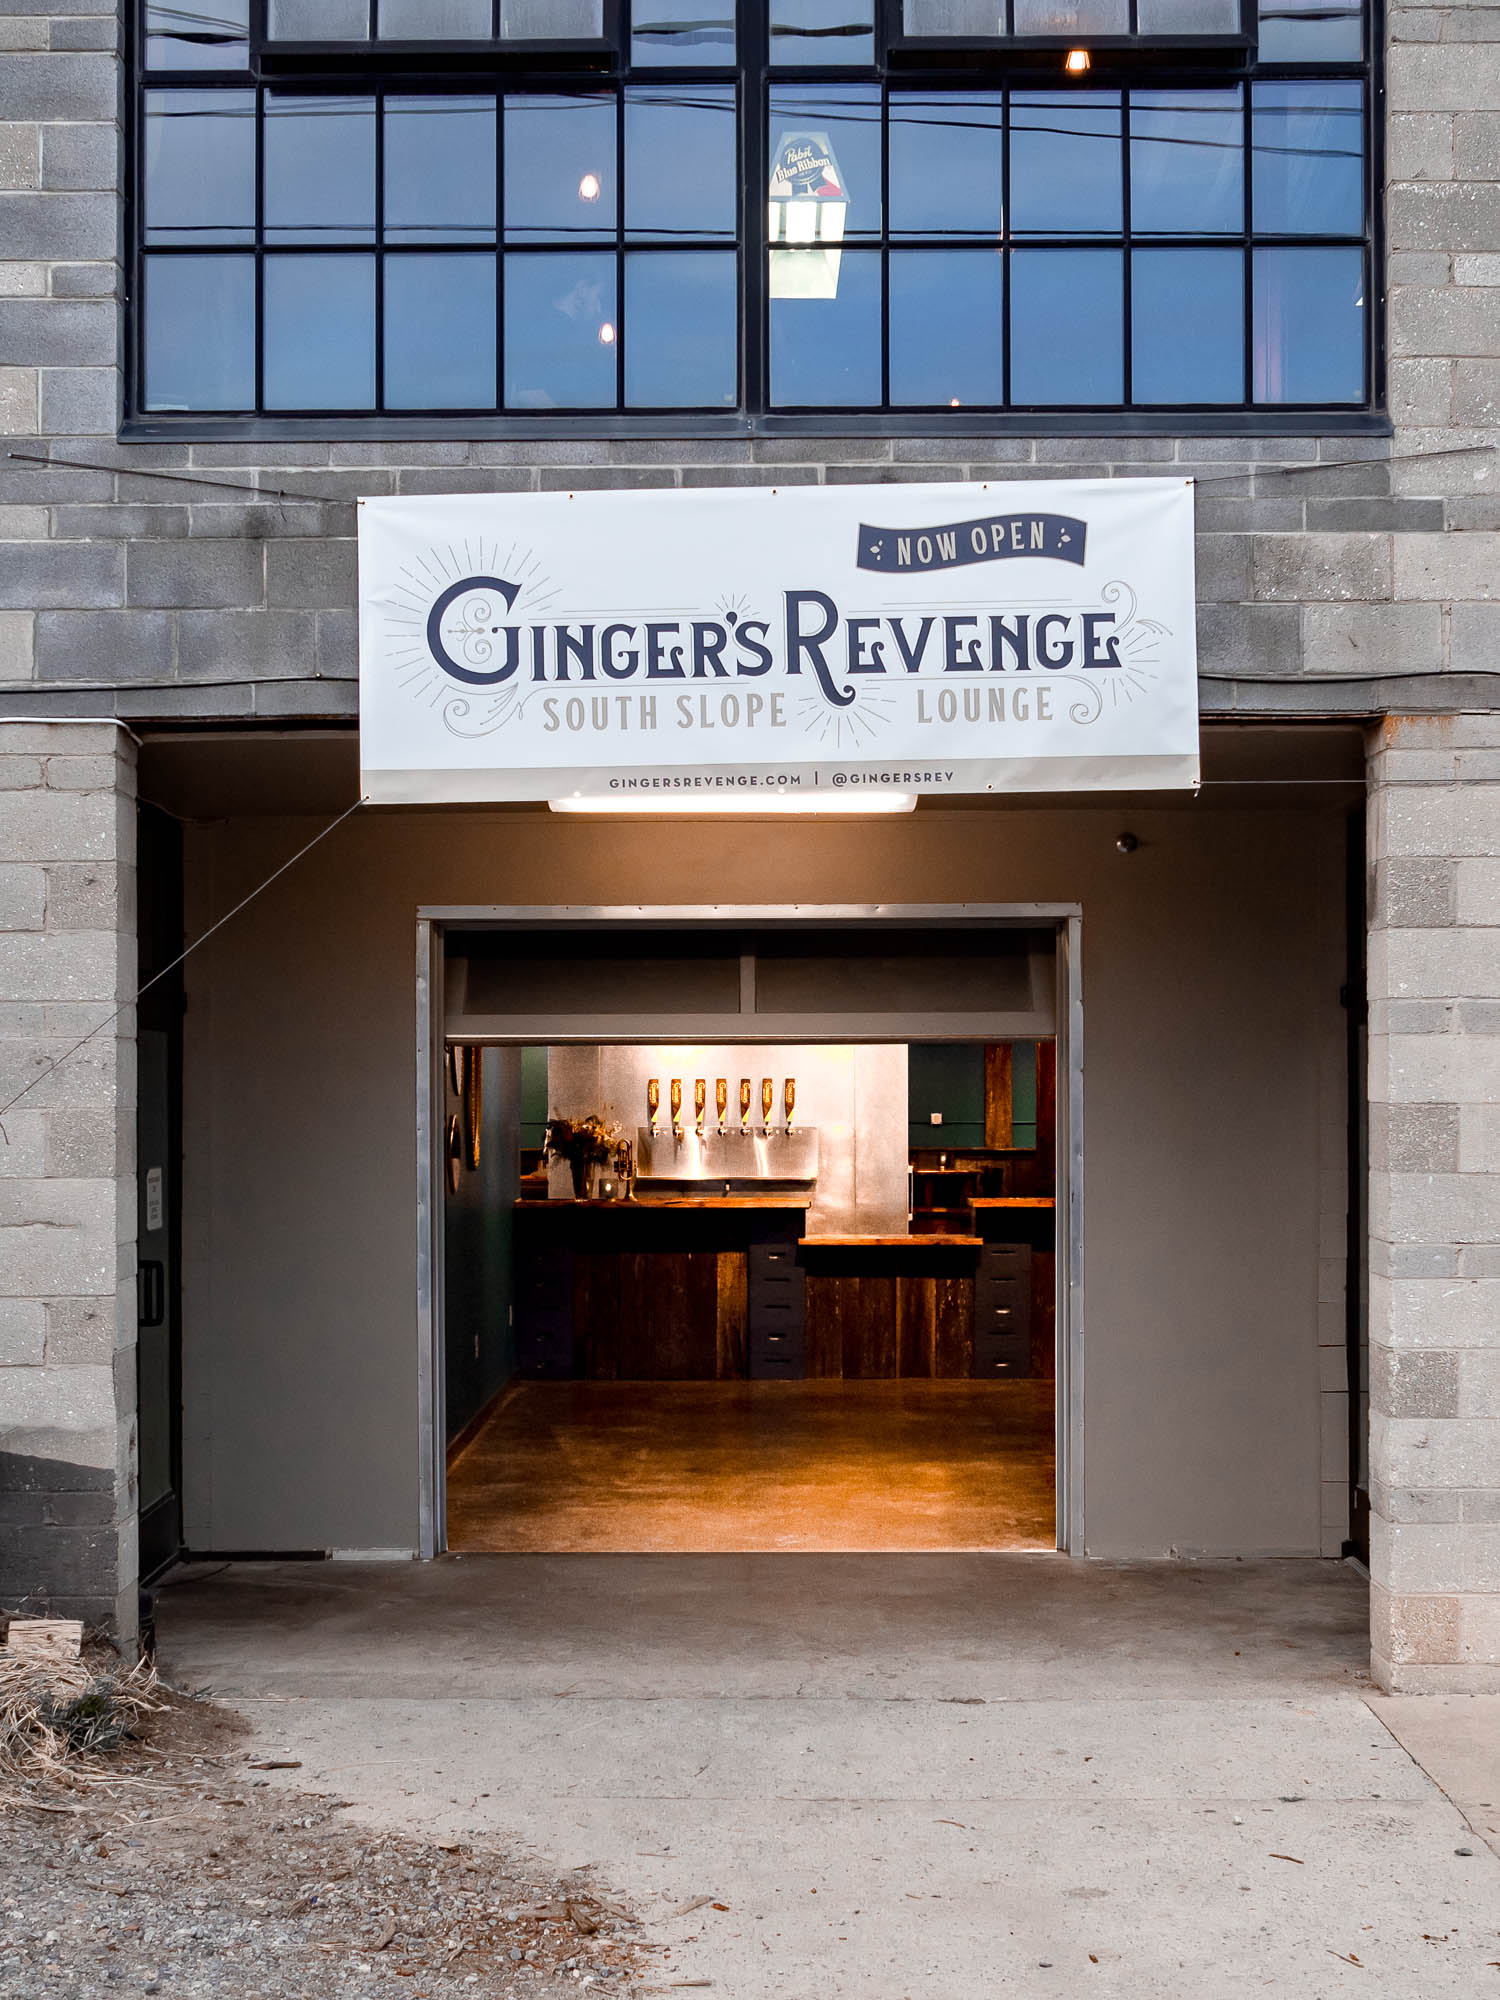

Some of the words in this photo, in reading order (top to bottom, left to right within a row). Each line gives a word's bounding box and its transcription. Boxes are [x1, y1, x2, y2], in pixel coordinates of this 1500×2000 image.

[776, 166, 798, 183] Blue
[796, 157, 831, 173] Ribbon
[784, 145, 812, 165] Pabst
[897, 531, 957, 566] NOW
[971, 521, 1045, 555] OPEN
[427, 576, 773, 686] GINGER'S
[783, 590, 1122, 707] REVENGE
[543, 696, 657, 732] SOUTH
[677, 693, 787, 729] SLOPE
[917, 687, 1053, 724] LOUNGE
[609, 775, 801, 789] GINGERSREVENGE.COM
[832, 772, 954, 787] @GINGERSREV
